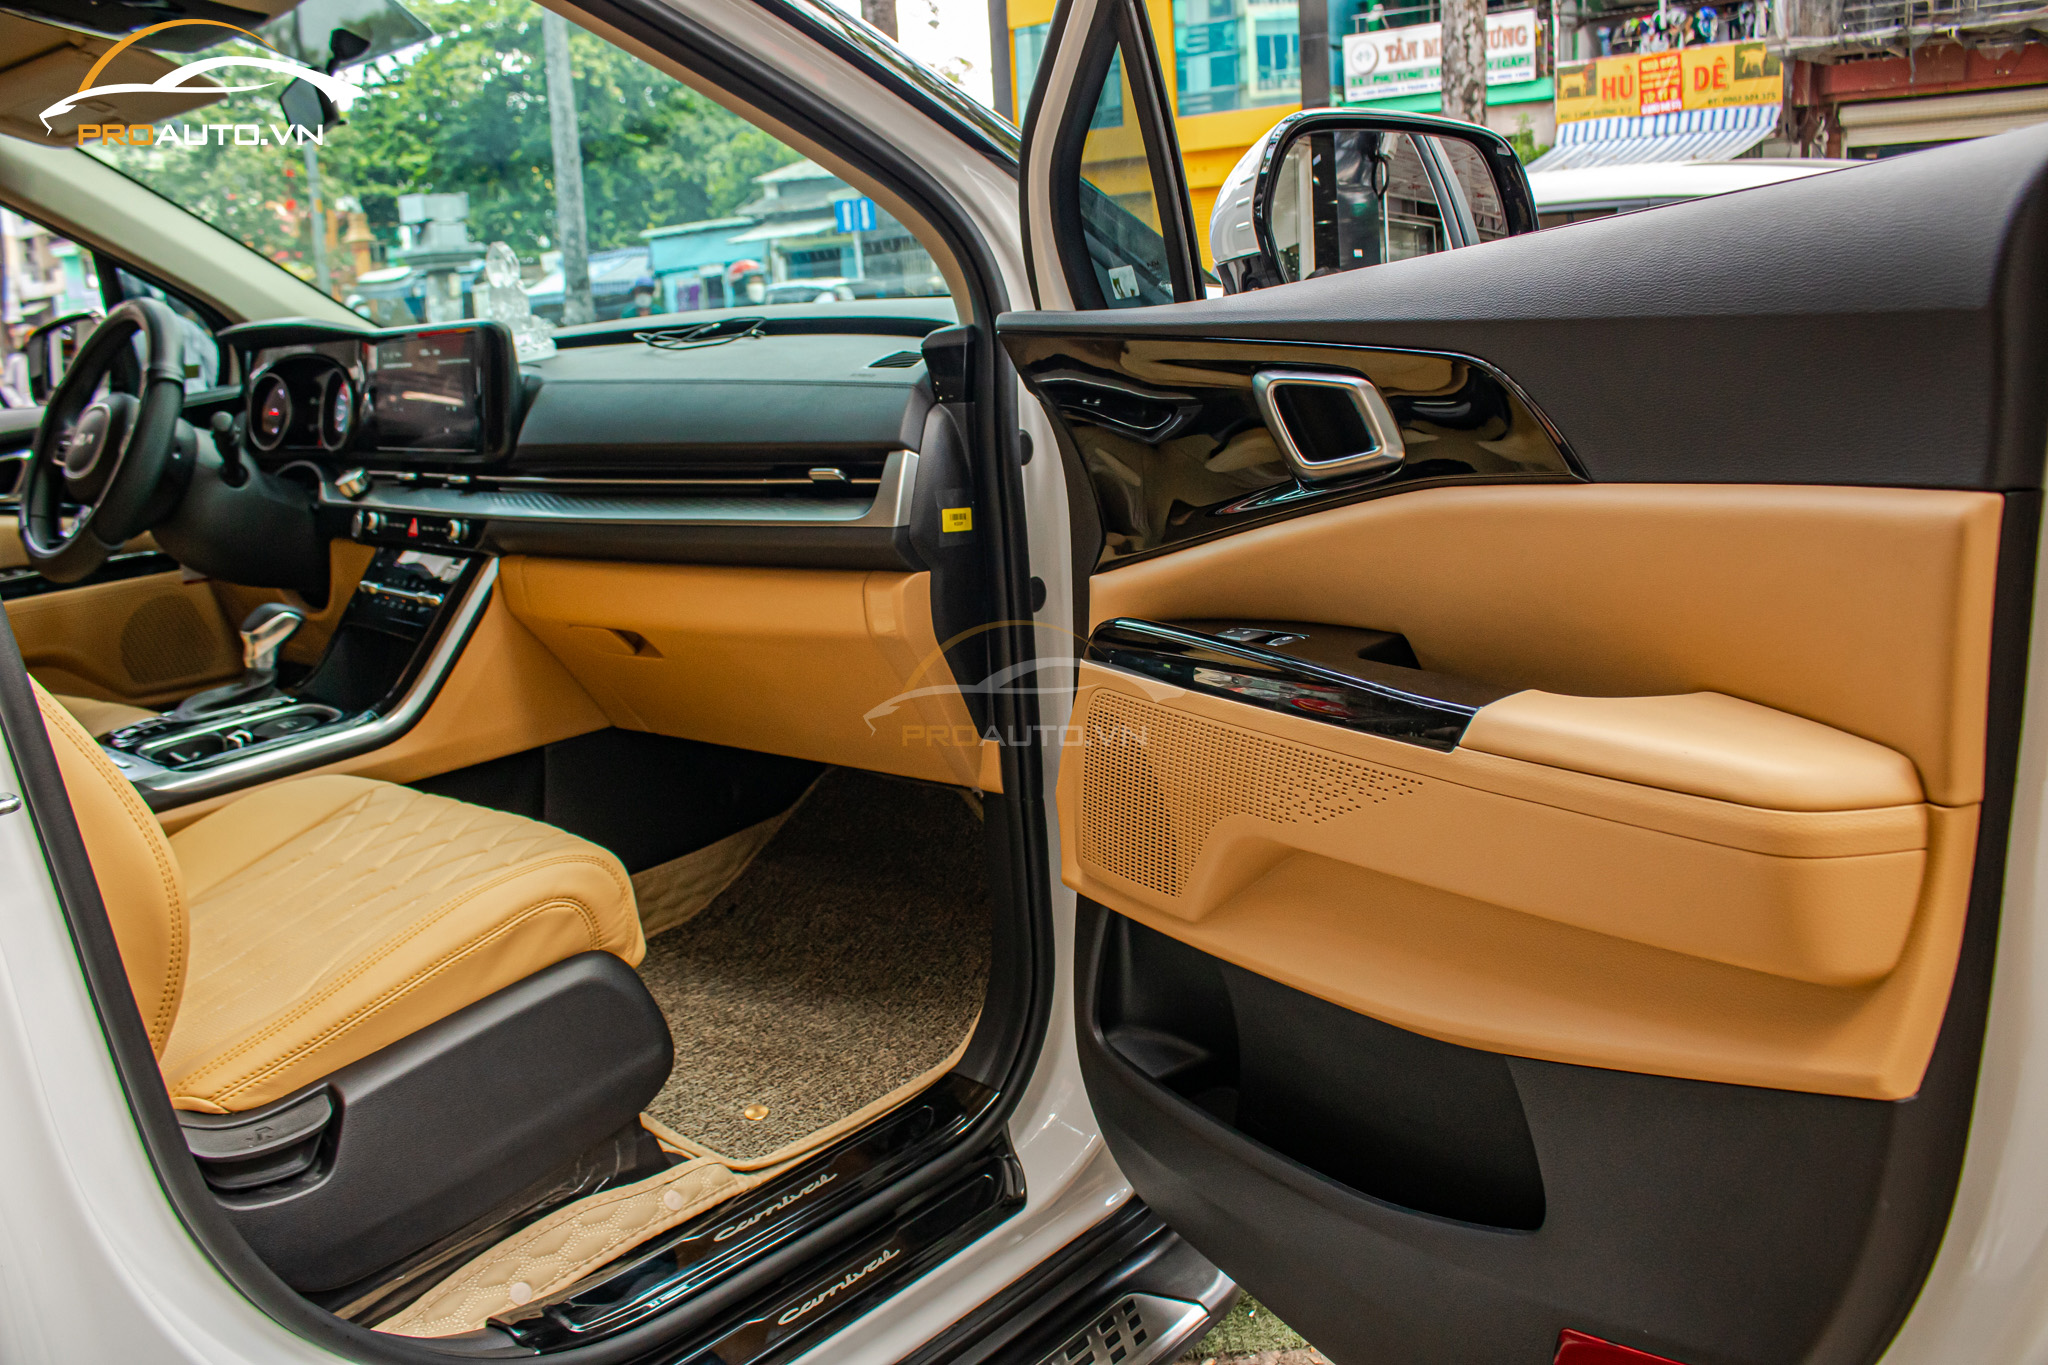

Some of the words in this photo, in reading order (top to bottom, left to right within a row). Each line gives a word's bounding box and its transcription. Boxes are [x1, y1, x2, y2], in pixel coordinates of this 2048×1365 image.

[1601, 64, 1633, 100] HỦ
[1694, 56, 1727, 91] DÊ
[713, 1173, 838, 1242] Carnival
[777, 1249, 900, 1325] Carnival
